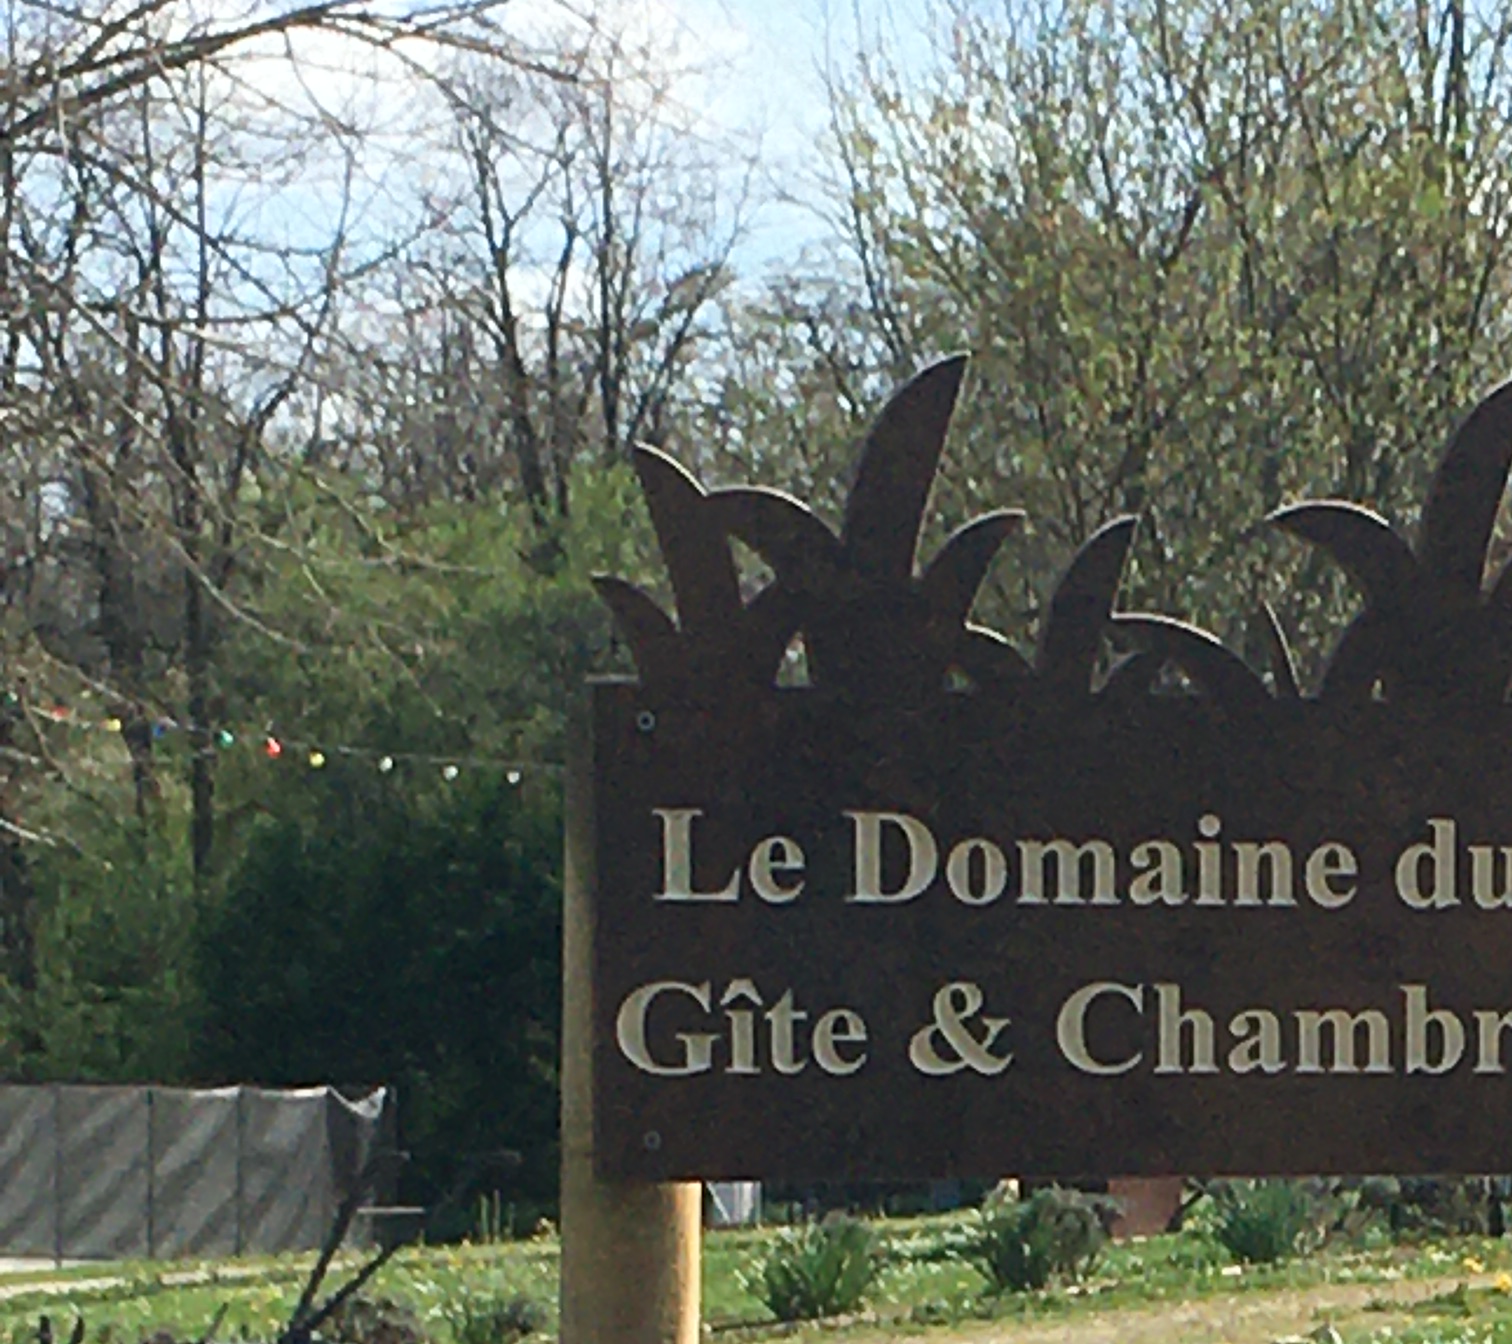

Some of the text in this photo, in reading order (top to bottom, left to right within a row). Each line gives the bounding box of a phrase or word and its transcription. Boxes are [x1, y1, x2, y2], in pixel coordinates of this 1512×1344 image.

[652, 807, 807, 905] Le
[844, 811, 1358, 906] Domaine
[615, 977, 870, 1076] Gîte
[908, 981, 1013, 1077] &
